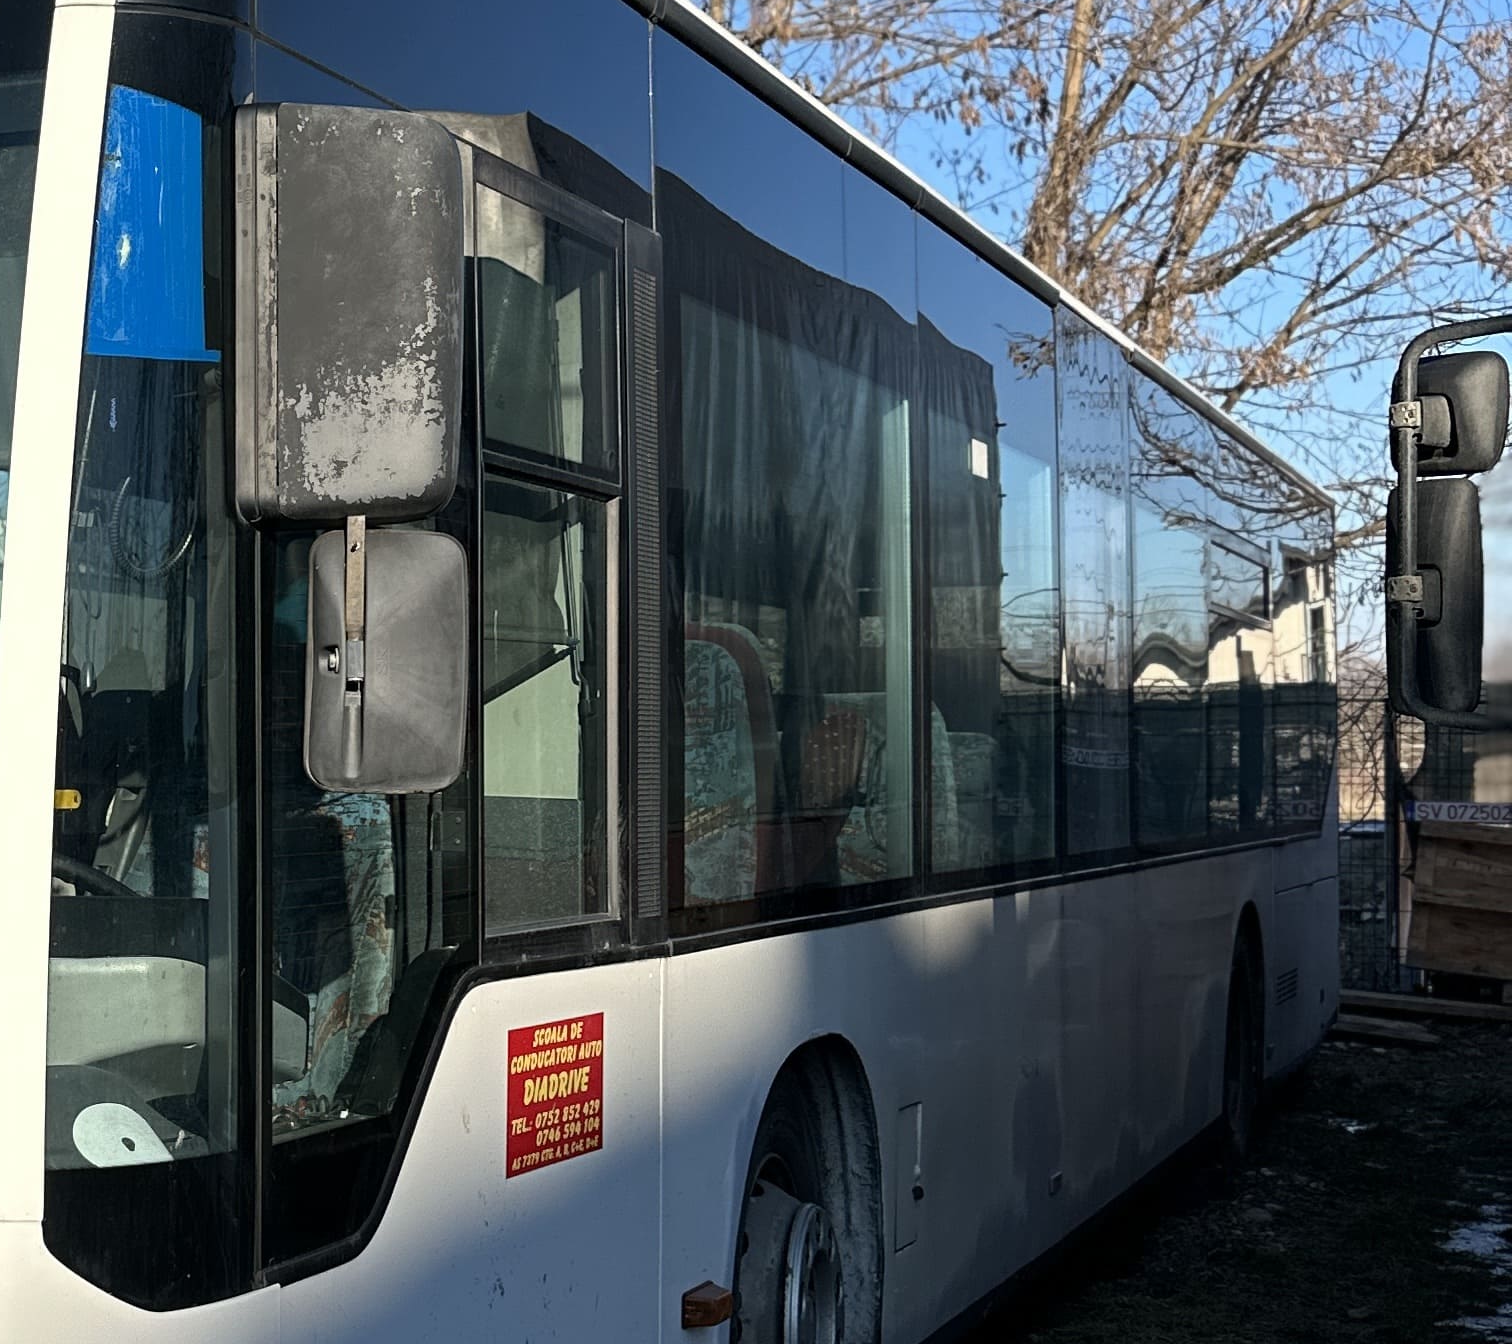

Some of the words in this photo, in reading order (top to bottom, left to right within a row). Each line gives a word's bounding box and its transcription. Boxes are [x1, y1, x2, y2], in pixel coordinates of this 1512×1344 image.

[1417, 803, 1442, 820] SV
[533, 1025, 568, 1047] SCOALA
[571, 1022, 584, 1040] DE
[510, 1044, 578, 1075] CONDUCATORI
[579, 1040, 602, 1060] AUTO
[524, 1067, 590, 1105] DIADRIVE
[535, 1109, 560, 1129] 0752
[562, 1103, 581, 1122] 852
[583, 1099, 600, 1116] 429
[536, 1126, 561, 1147] 0746
[562, 1120, 582, 1139] 594
[584, 1116, 600, 1133] 104
